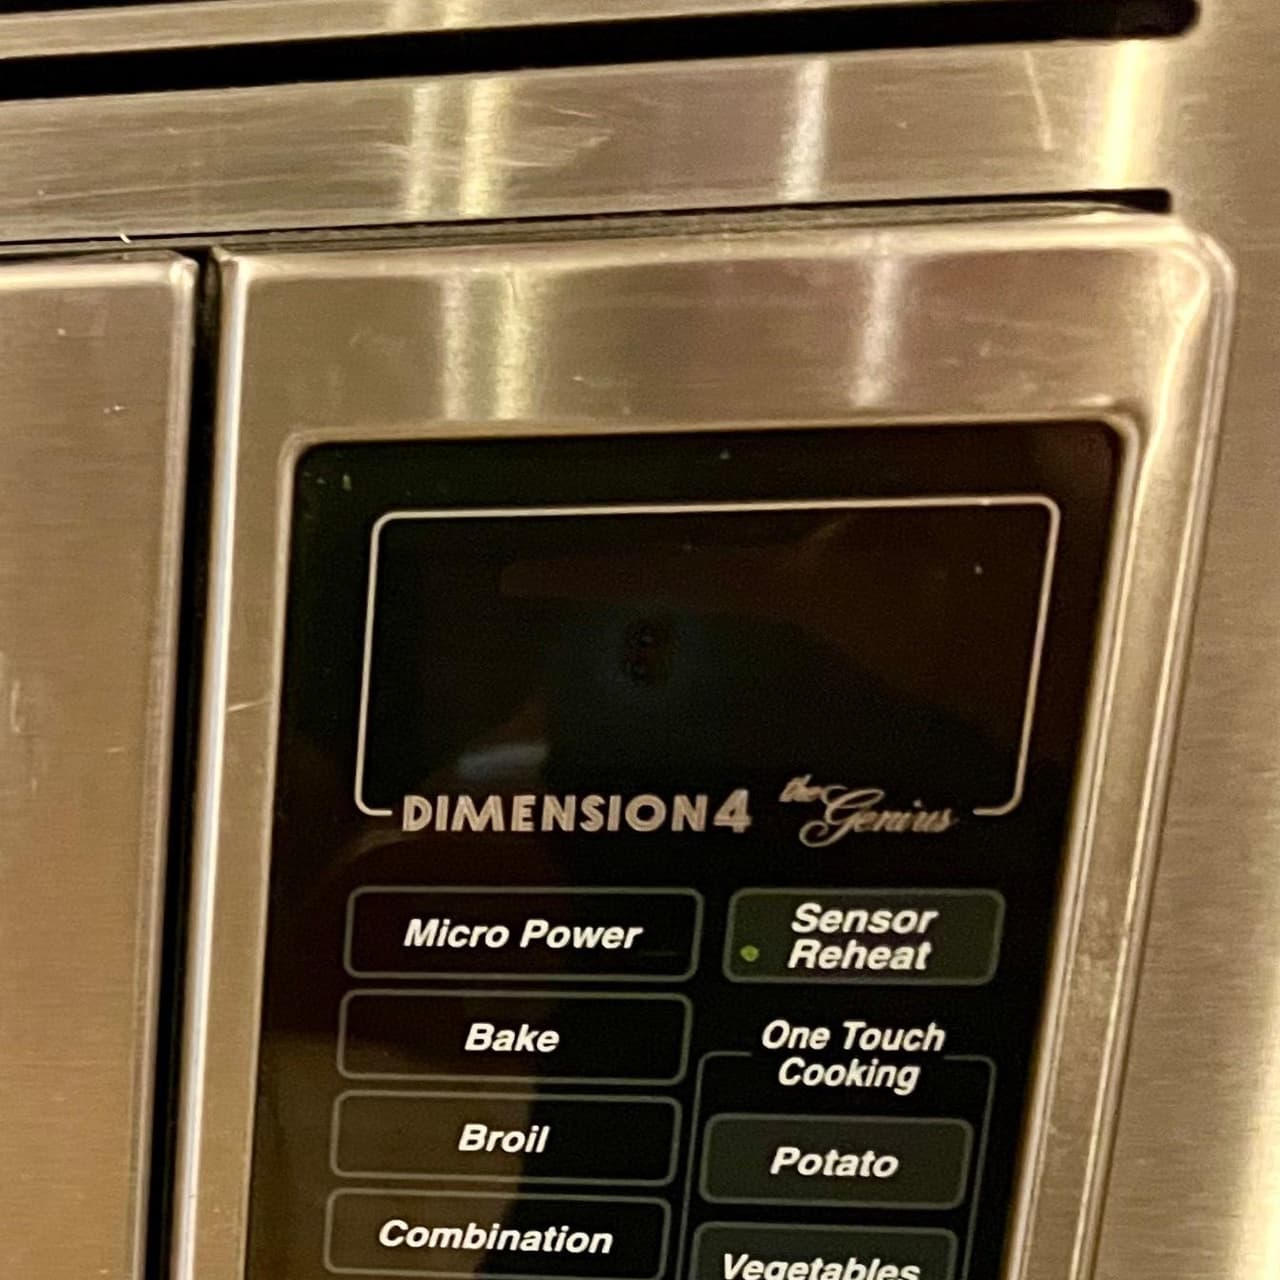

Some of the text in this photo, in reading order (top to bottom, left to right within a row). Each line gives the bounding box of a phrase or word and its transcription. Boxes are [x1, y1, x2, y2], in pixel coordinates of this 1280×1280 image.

[797, 785, 959, 850] Genius
[402, 917, 645, 950] Micro Power
[790, 901, 940, 937] Sensor
[786, 937, 933, 971] Reheat
[463, 1021, 561, 1054] Bake
[760, 1018, 947, 1053] One Touch
[777, 1055, 922, 1097] Cooking
[457, 1122, 551, 1154] Broil
[769, 1145, 900, 1179] Potato
[377, 1218, 614, 1255] Combination
